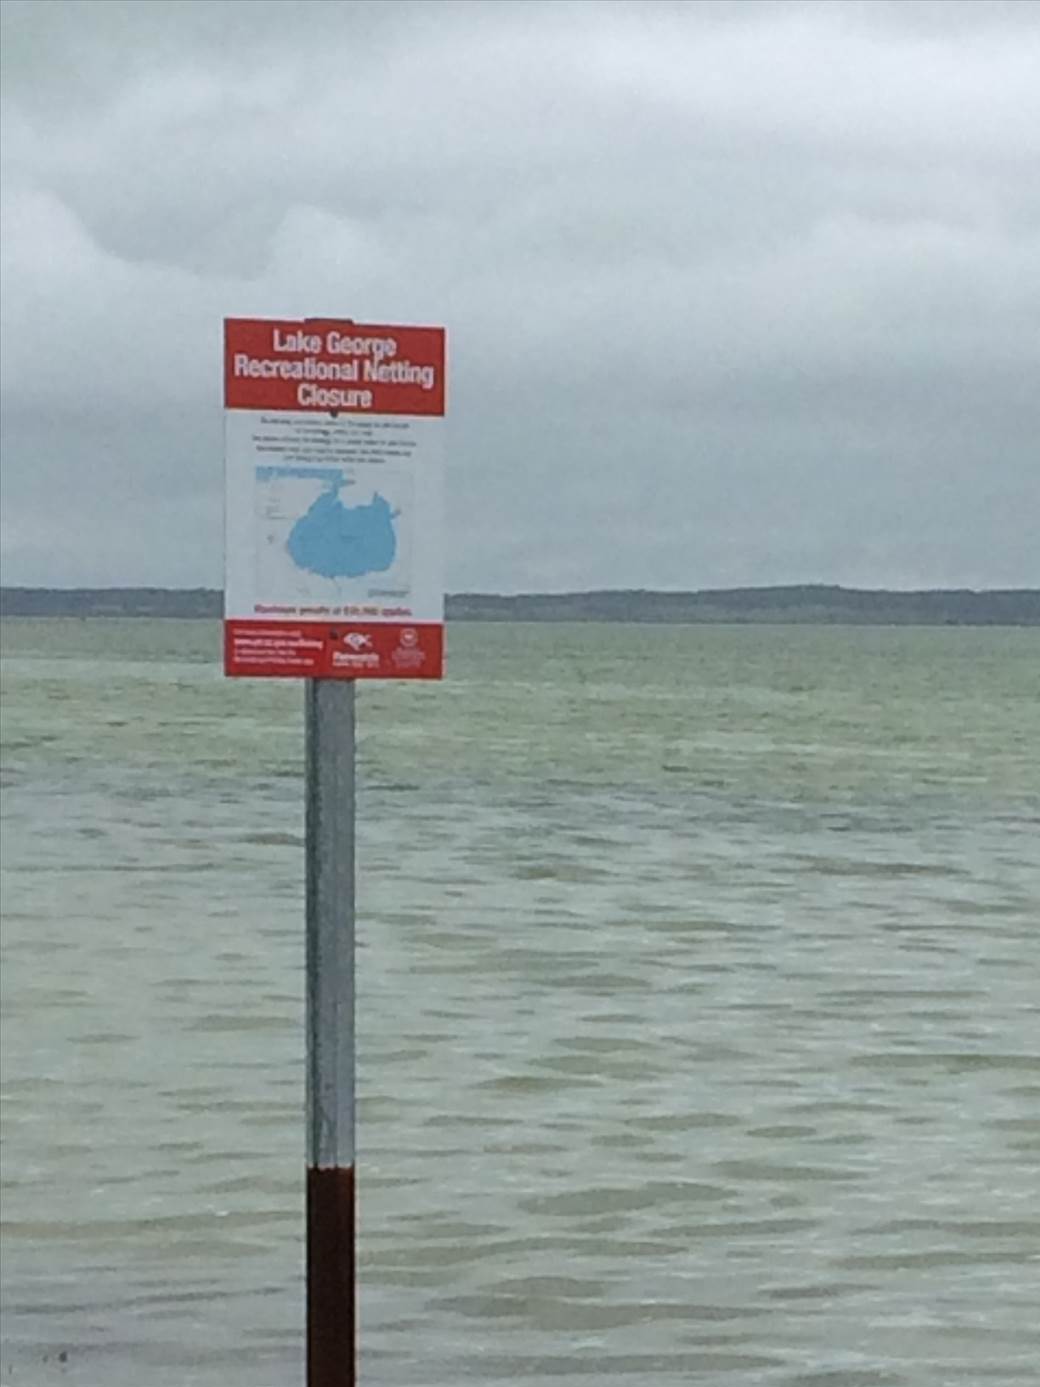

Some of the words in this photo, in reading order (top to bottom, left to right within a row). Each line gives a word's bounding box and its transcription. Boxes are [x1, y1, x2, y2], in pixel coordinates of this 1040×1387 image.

[273, 329, 322, 352] Lake
[327, 331, 397, 358] George
[234, 354, 357, 381] Recreational
[363, 359, 434, 388] Netting
[297, 383, 372, 408] Closure
